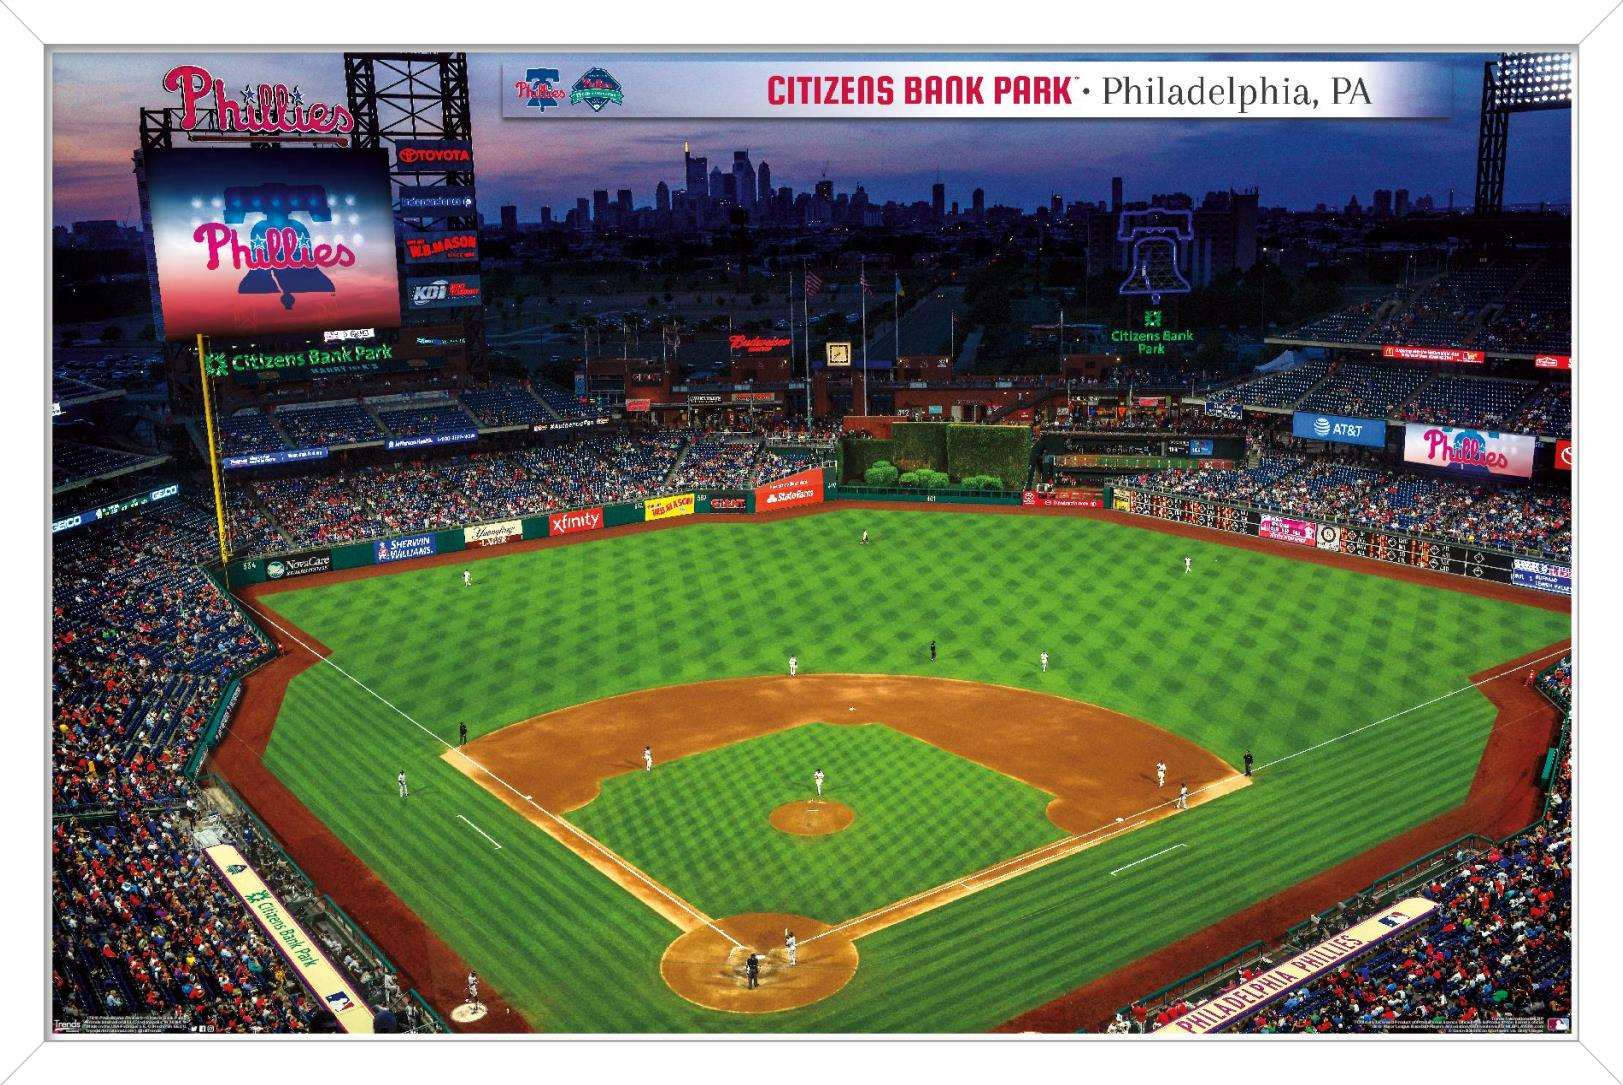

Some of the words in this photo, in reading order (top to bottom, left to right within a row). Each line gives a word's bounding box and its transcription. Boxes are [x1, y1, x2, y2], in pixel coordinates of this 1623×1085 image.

[163, 65, 355, 133] Phillies
[417, 149, 470, 162] TOYOTA
[193, 221, 356, 271] Phillies
[729, 335, 791, 349] Budweiser
[1111, 330, 1160, 342] Citizens
[1163, 330, 1194, 341] Bank
[232, 351, 306, 372] Citizens
[309, 346, 353, 366] Bank
[355, 342, 393, 361] Park
[1138, 343, 1166, 354] Park
[1333, 423, 1363, 437] AT&T
[1423, 428, 1508, 469] Phillies
[151, 484, 178, 501] GEICO
[52, 515, 82, 532] GEICO
[552, 512, 601, 533] xfinity
[390, 537, 431, 550] SHERWIN
[286, 556, 330, 569] NovaCare
[257, 901, 287, 932] Citizens
[280, 928, 304, 950] Bank
[295, 947, 320, 969] Park
[1175, 970, 1300, 1034] PHILADELPHIA
[1291, 933, 1364, 973] PHILLIES
